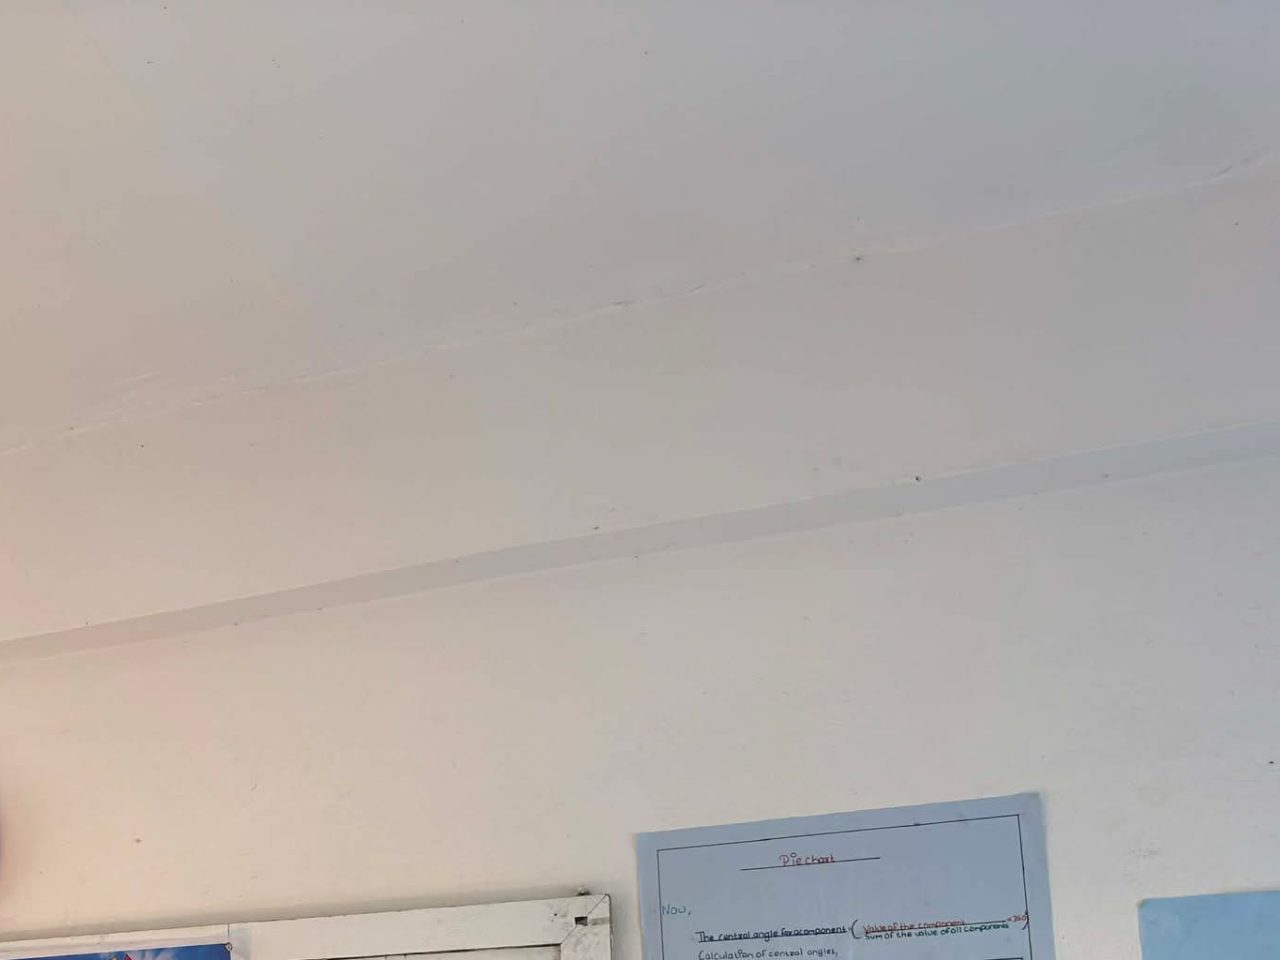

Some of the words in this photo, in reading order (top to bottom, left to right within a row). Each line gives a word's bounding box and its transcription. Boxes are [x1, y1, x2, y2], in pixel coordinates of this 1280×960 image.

[780, 851, 801, 867] Pie
[661, 905, 691, 916] Now,
[695, 931, 714, 943] The
[753, 929, 778, 942] angle
[896, 929, 912, 938] the
[756, 948, 767, 959] of
